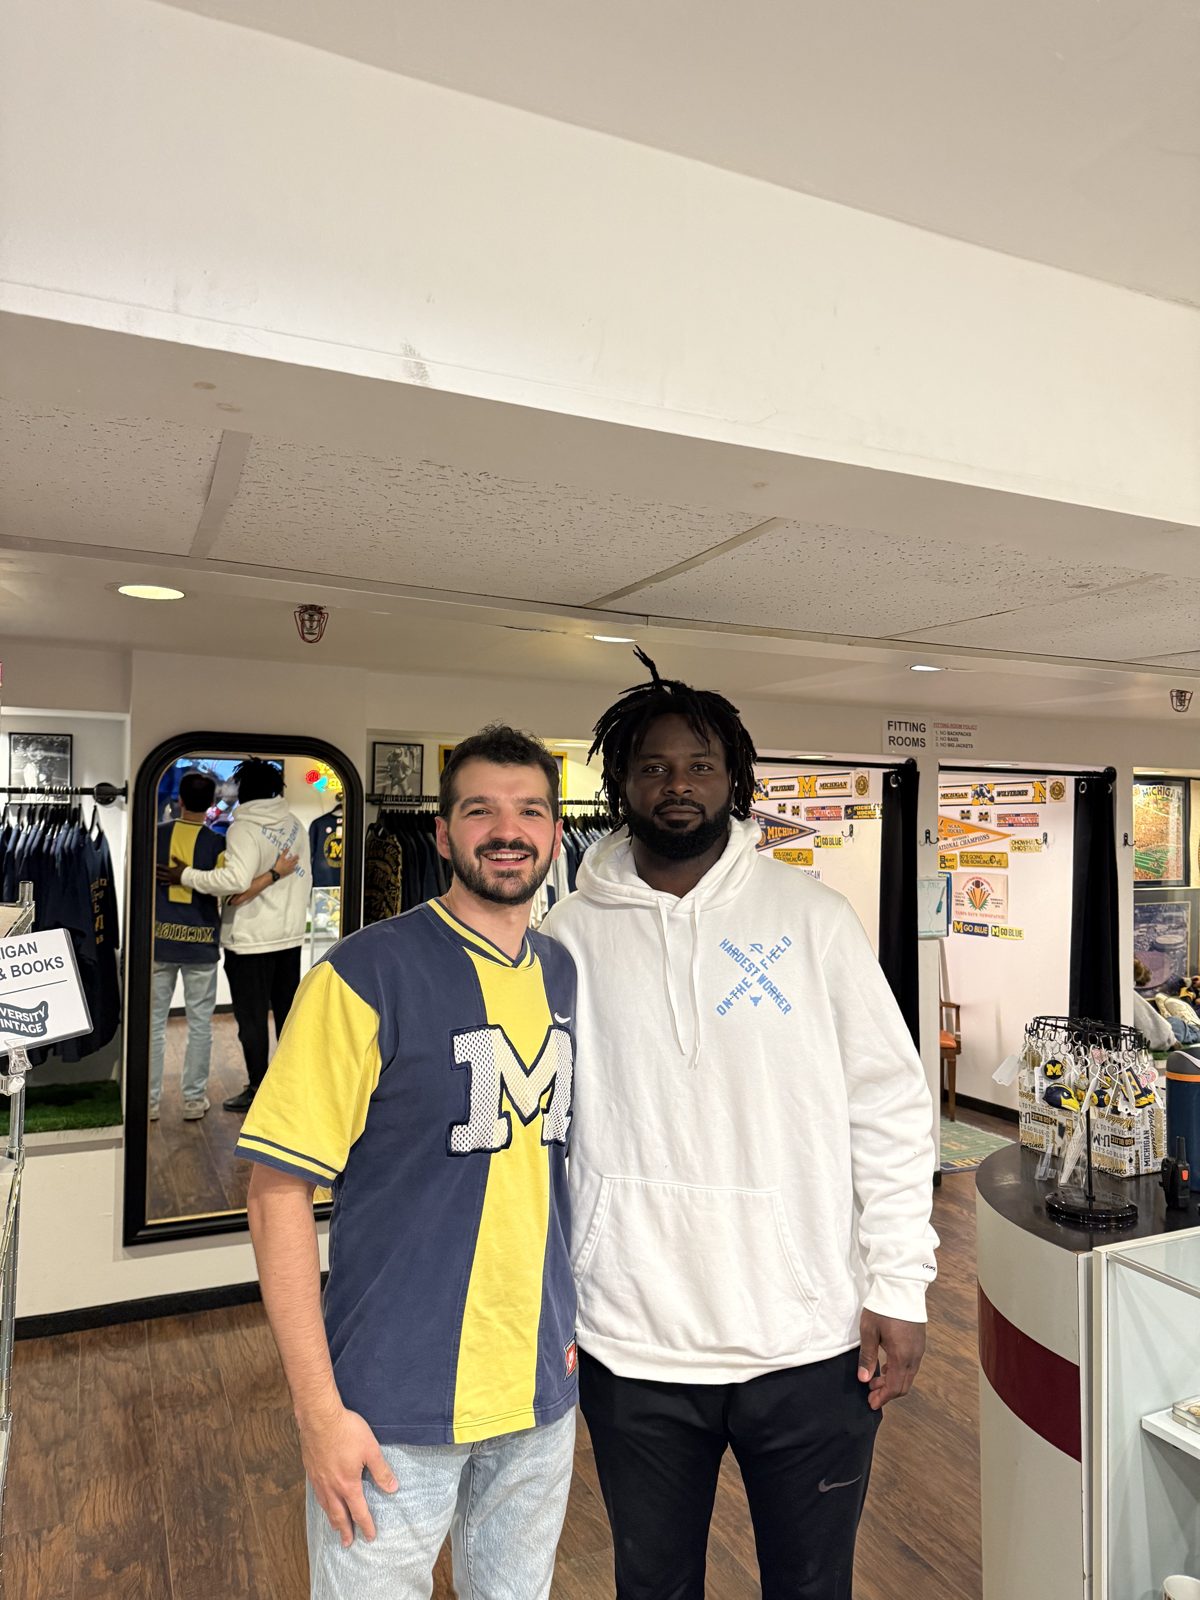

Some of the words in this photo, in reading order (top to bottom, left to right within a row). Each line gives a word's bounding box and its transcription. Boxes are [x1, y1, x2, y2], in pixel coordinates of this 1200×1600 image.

[887, 720, 926, 733] FITTING
[888, 735, 926, 748] ROOMS
[797, 775, 818, 798] M
[819, 781, 847, 790] MICHIGAN
[767, 825, 800, 840] MICHIGAN
[960, 833, 990, 847] CHAMPIONS
[822, 838, 829, 846] GO
[829, 837, 842, 846] BLUE
[953, 920, 963, 934] M
[974, 925, 988, 935] BLUE
[991, 925, 1000, 937] M
[1000, 928, 1008, 936] GO
[1008, 929, 1023, 938] BLUE
[0, 941, 38, 960] IGAN
[759, 935, 792, 970] FIELD
[10, 956, 64, 978] BOOKS
[719, 938, 761, 977] HARDEST
[756, 972, 792, 1015] WORKER
[1046, 1063, 1062, 1076] M
[446, 1024, 573, 1157] M
[1092, 1163, 1127, 1176] olverines
